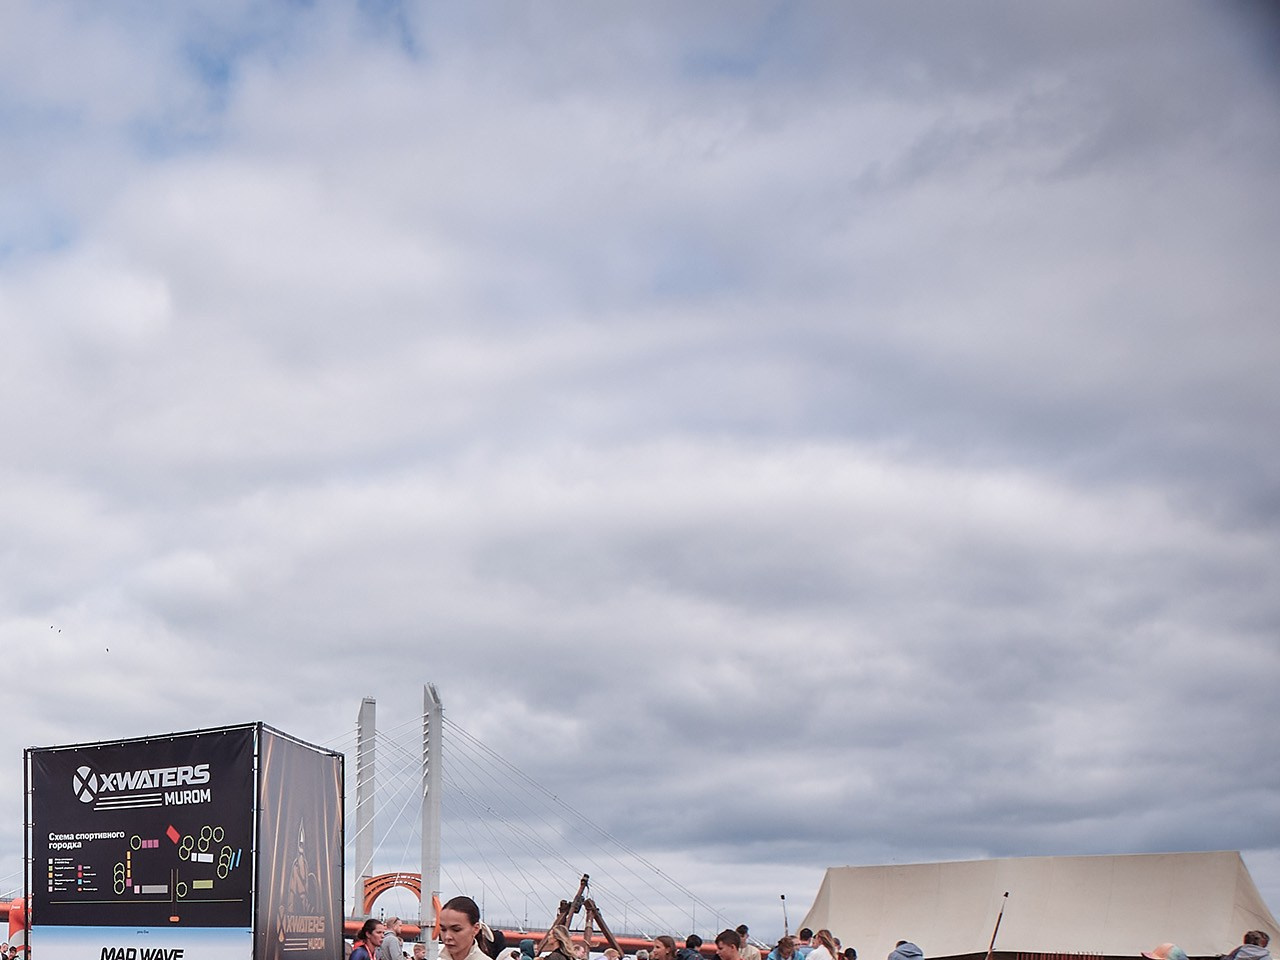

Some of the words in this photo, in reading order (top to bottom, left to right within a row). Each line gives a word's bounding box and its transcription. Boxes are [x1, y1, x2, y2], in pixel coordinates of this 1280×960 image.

[164, 788, 211, 806] MUROM
[48, 832, 74, 841] Схема
[75, 831, 125, 841] спортивного
[48, 841, 82, 851] городка
